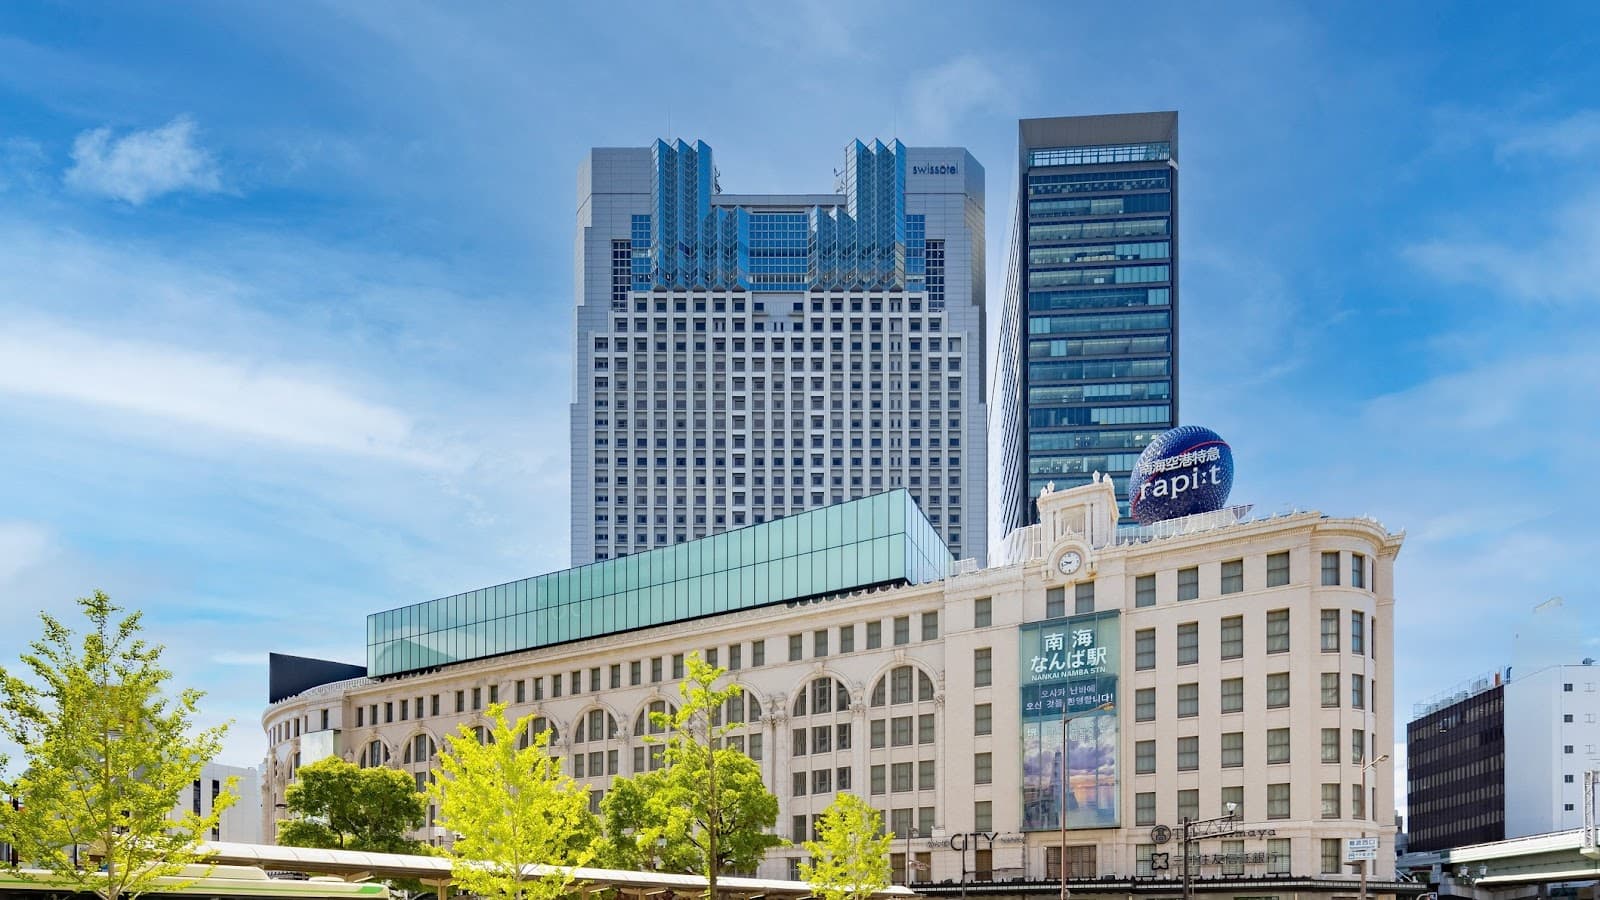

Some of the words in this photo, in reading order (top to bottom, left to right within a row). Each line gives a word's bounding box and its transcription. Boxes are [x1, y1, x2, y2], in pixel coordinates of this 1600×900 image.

[1030, 646, 1107, 673] なんば駅
[1031, 672, 1059, 681] NANKAI
[950, 832, 998, 851] CITY
